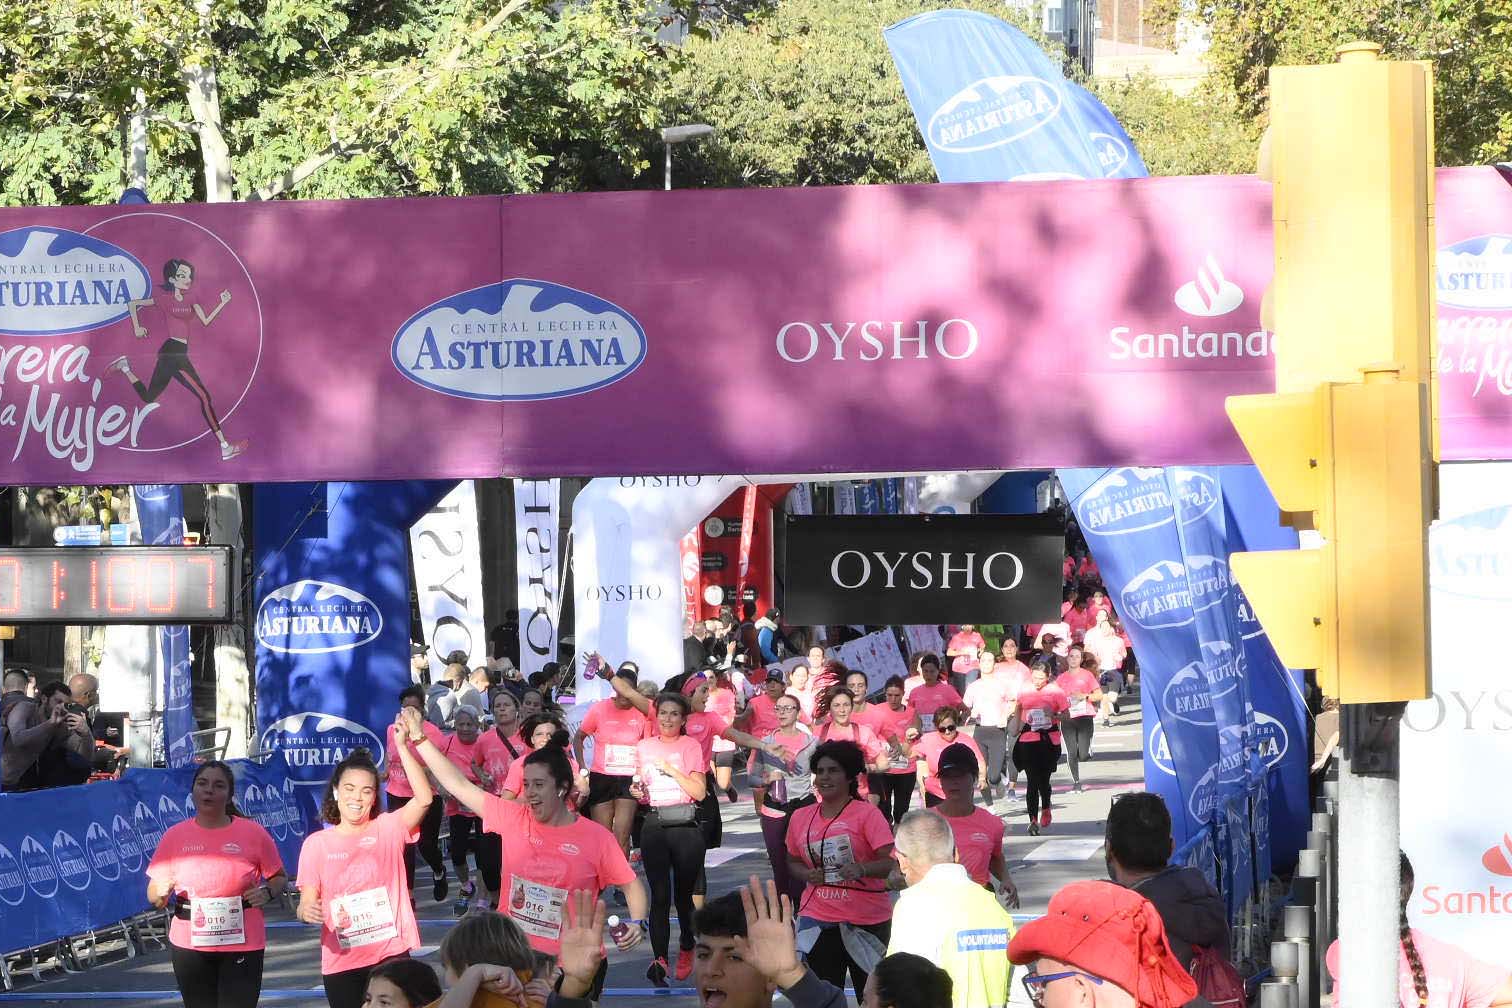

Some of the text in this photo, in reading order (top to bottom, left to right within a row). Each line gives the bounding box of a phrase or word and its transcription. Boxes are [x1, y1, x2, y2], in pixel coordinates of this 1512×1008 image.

[54, 262, 126, 274] LECHERA
[450, 319, 619, 335] CENTRAL LECHERA
[776, 318, 979, 363] OYSHO
[1110, 325, 1276, 361] Santand
[412, 326, 626, 372] ASTURIANA
[11, 376, 161, 472] Mujer
[830, 550, 1024, 591] OYSHO
[586, 585, 663, 602] OYSHO
[260, 608, 374, 638] ASTURIANA
[1403, 690, 1512, 735] OYS
[1422, 885, 1512, 917] Santa
